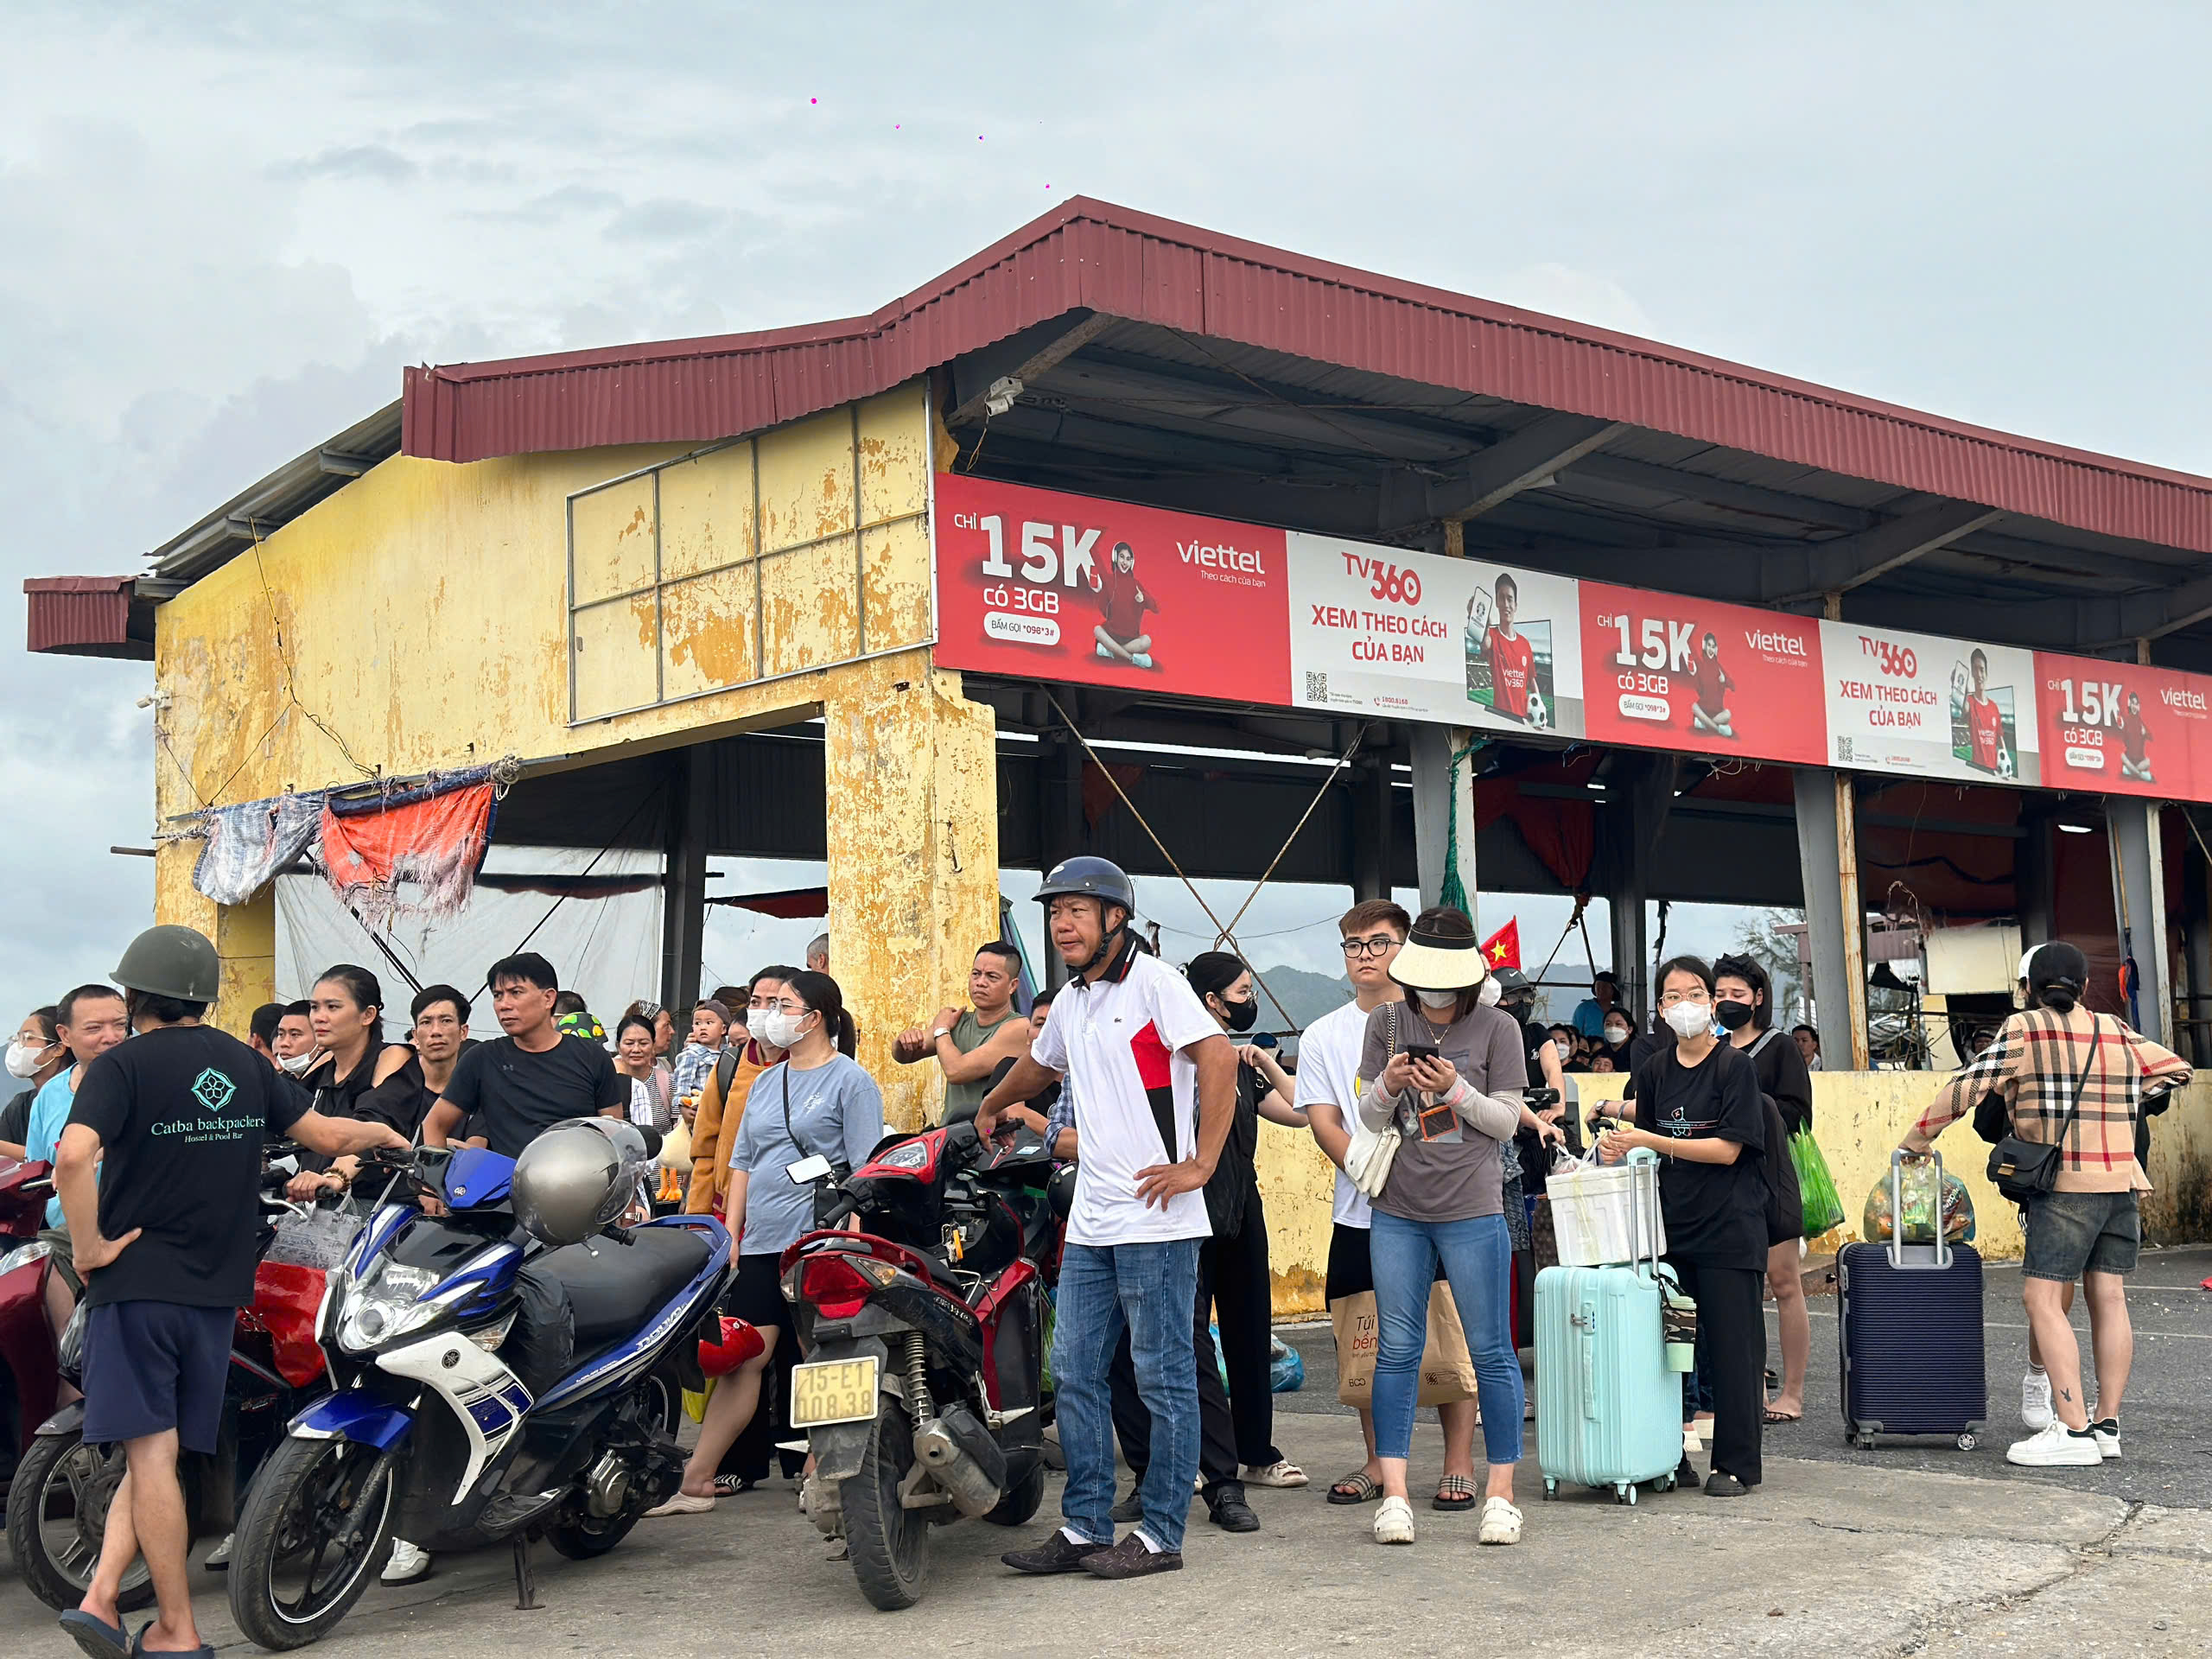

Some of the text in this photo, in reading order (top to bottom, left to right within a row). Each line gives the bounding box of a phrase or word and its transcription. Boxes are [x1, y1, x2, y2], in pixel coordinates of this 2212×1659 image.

[954, 512, 977, 530] CHỈ
[981, 515, 1102, 588] 15K
[1201, 570, 1218, 581] Theo
[1341, 551, 1422, 606] TV360
[1014, 587, 1059, 614] 3GB
[991, 618, 1007, 630] BẤM
[1008, 622, 1021, 633] GỌI
[1312, 604, 1357, 629] XEM
[1362, 611, 1408, 634] THEO
[1411, 615, 1447, 639] CÁCH
[1351, 635, 1424, 665] CỦA BẠN
[1614, 614, 1695, 672] 15K
[1859, 635, 1917, 679] TV360
[1637, 672, 1669, 695] 3GB
[1840, 680, 1937, 705] XEM THEO CÁCH
[2061, 678, 2123, 727] 15K
[1869, 705, 1922, 729] CỦA BẠN
[2079, 728, 2103, 747] 3GB
[151, 1116, 265, 1135] Catba backpackers
[1357, 1314, 1376, 1332] Túi
[1352, 1331, 1377, 1350] bền
[806, 1363, 863, 1394] 15-E1
